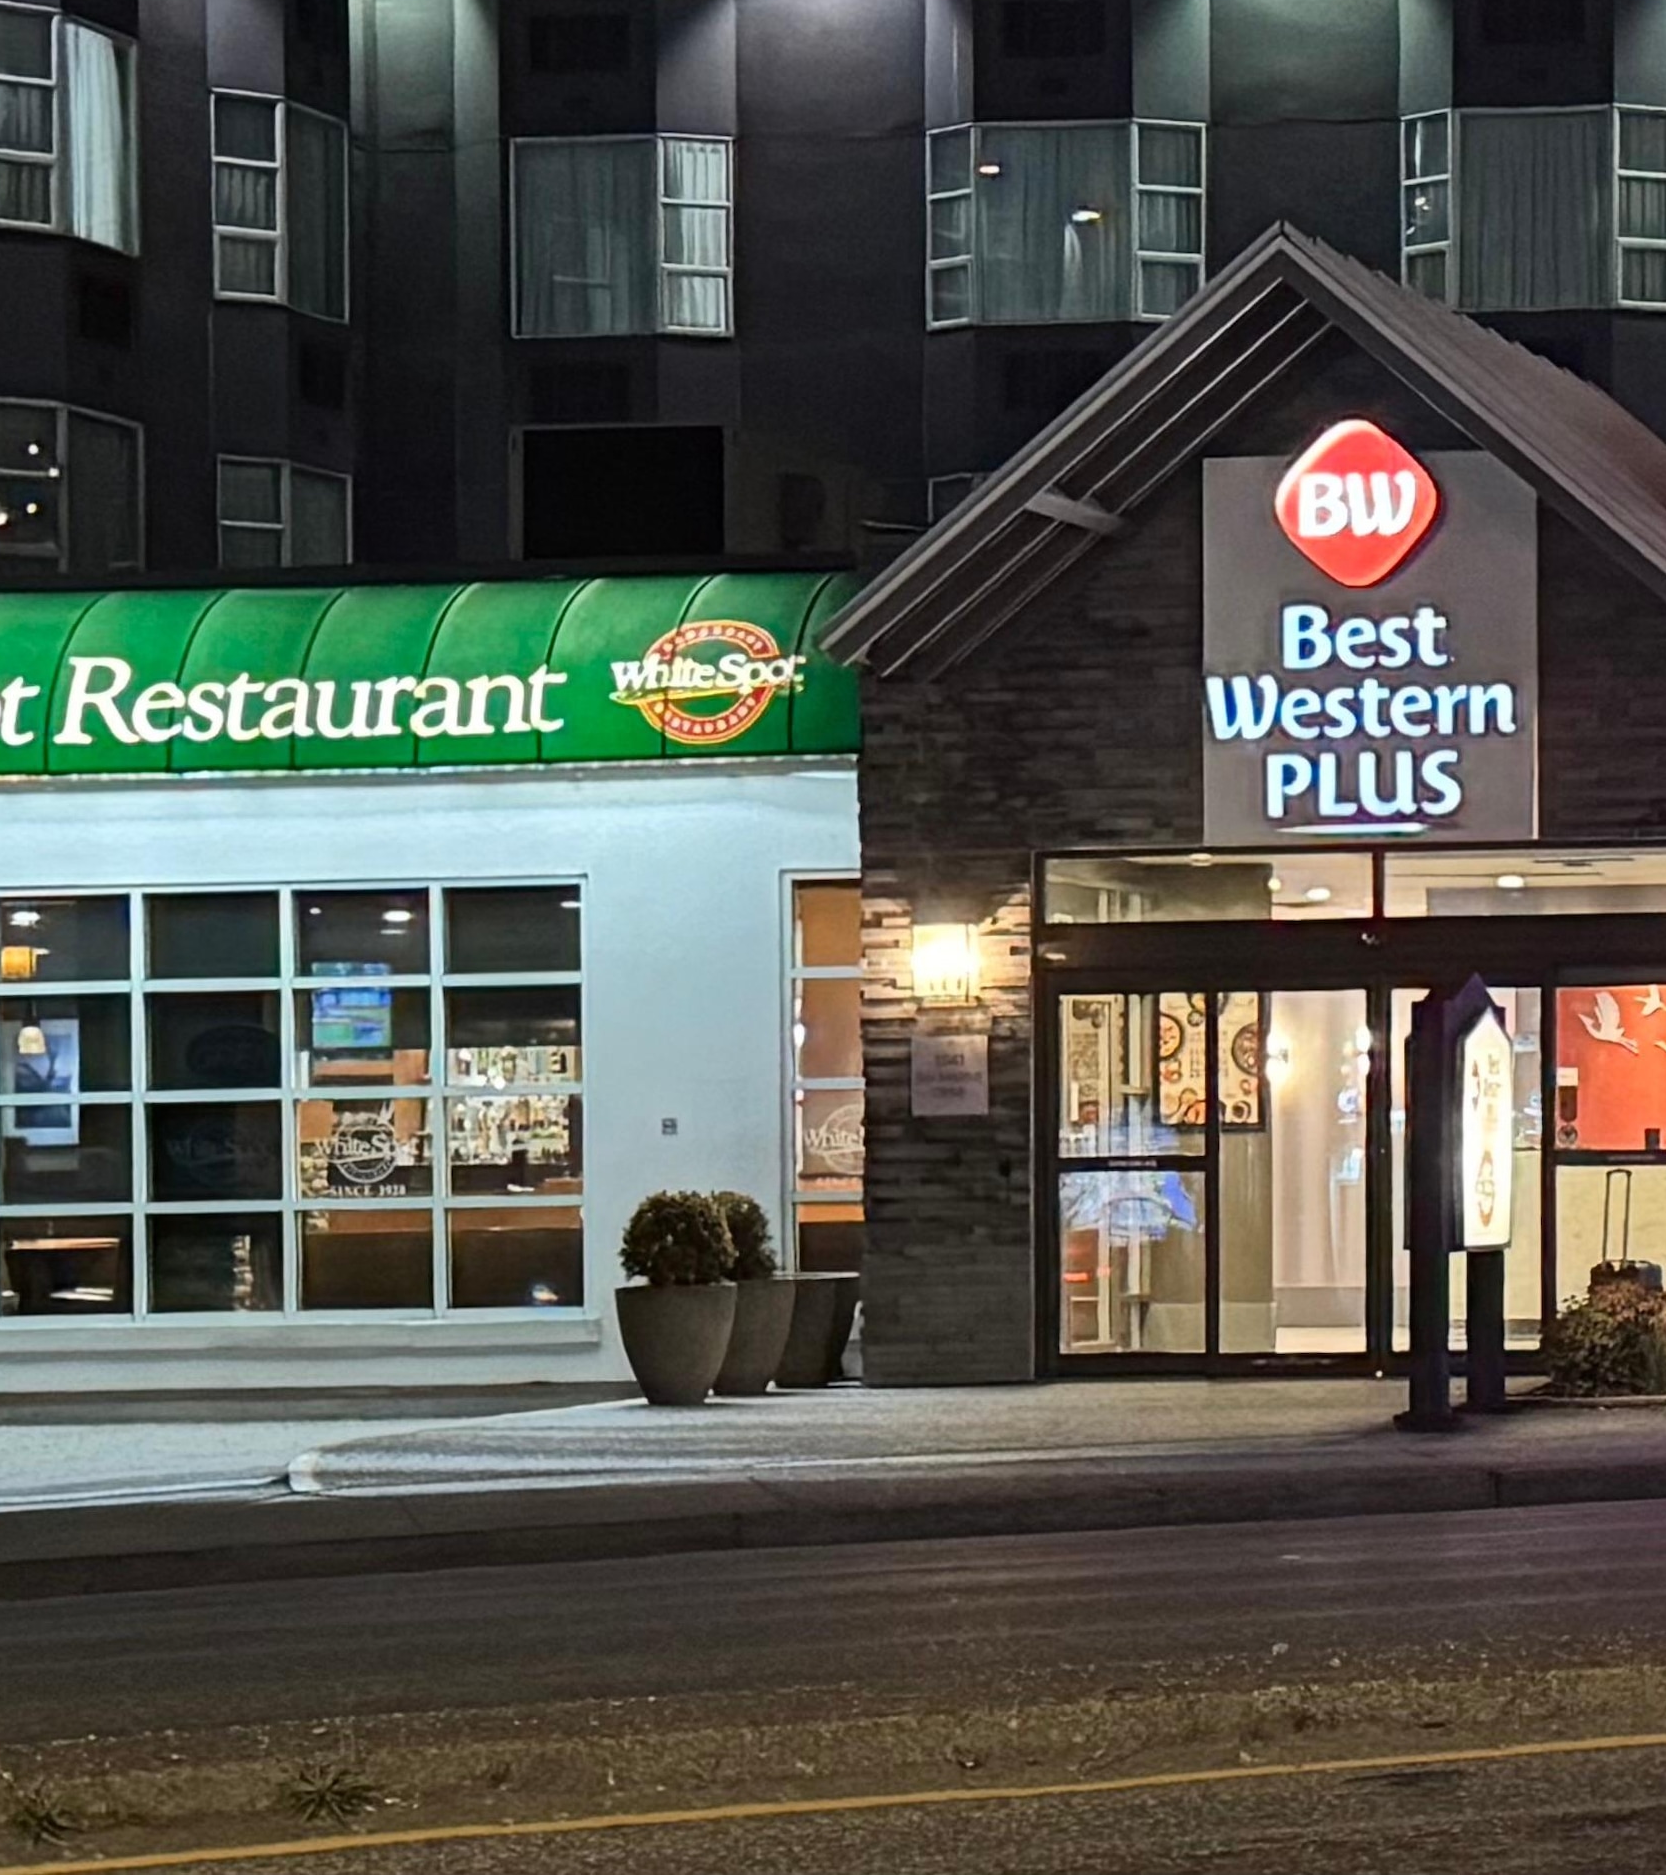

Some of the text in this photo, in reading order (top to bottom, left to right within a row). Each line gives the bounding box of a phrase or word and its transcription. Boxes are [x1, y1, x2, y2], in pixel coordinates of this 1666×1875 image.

[1297, 470, 1417, 538] BW
[1281, 603, 1450, 671] Best
[52, 655, 568, 746] Restaurant
[610, 652, 807, 695] White Spot
[1204, 674, 1517, 741] Western
[1265, 749, 1463, 819] PLUS
